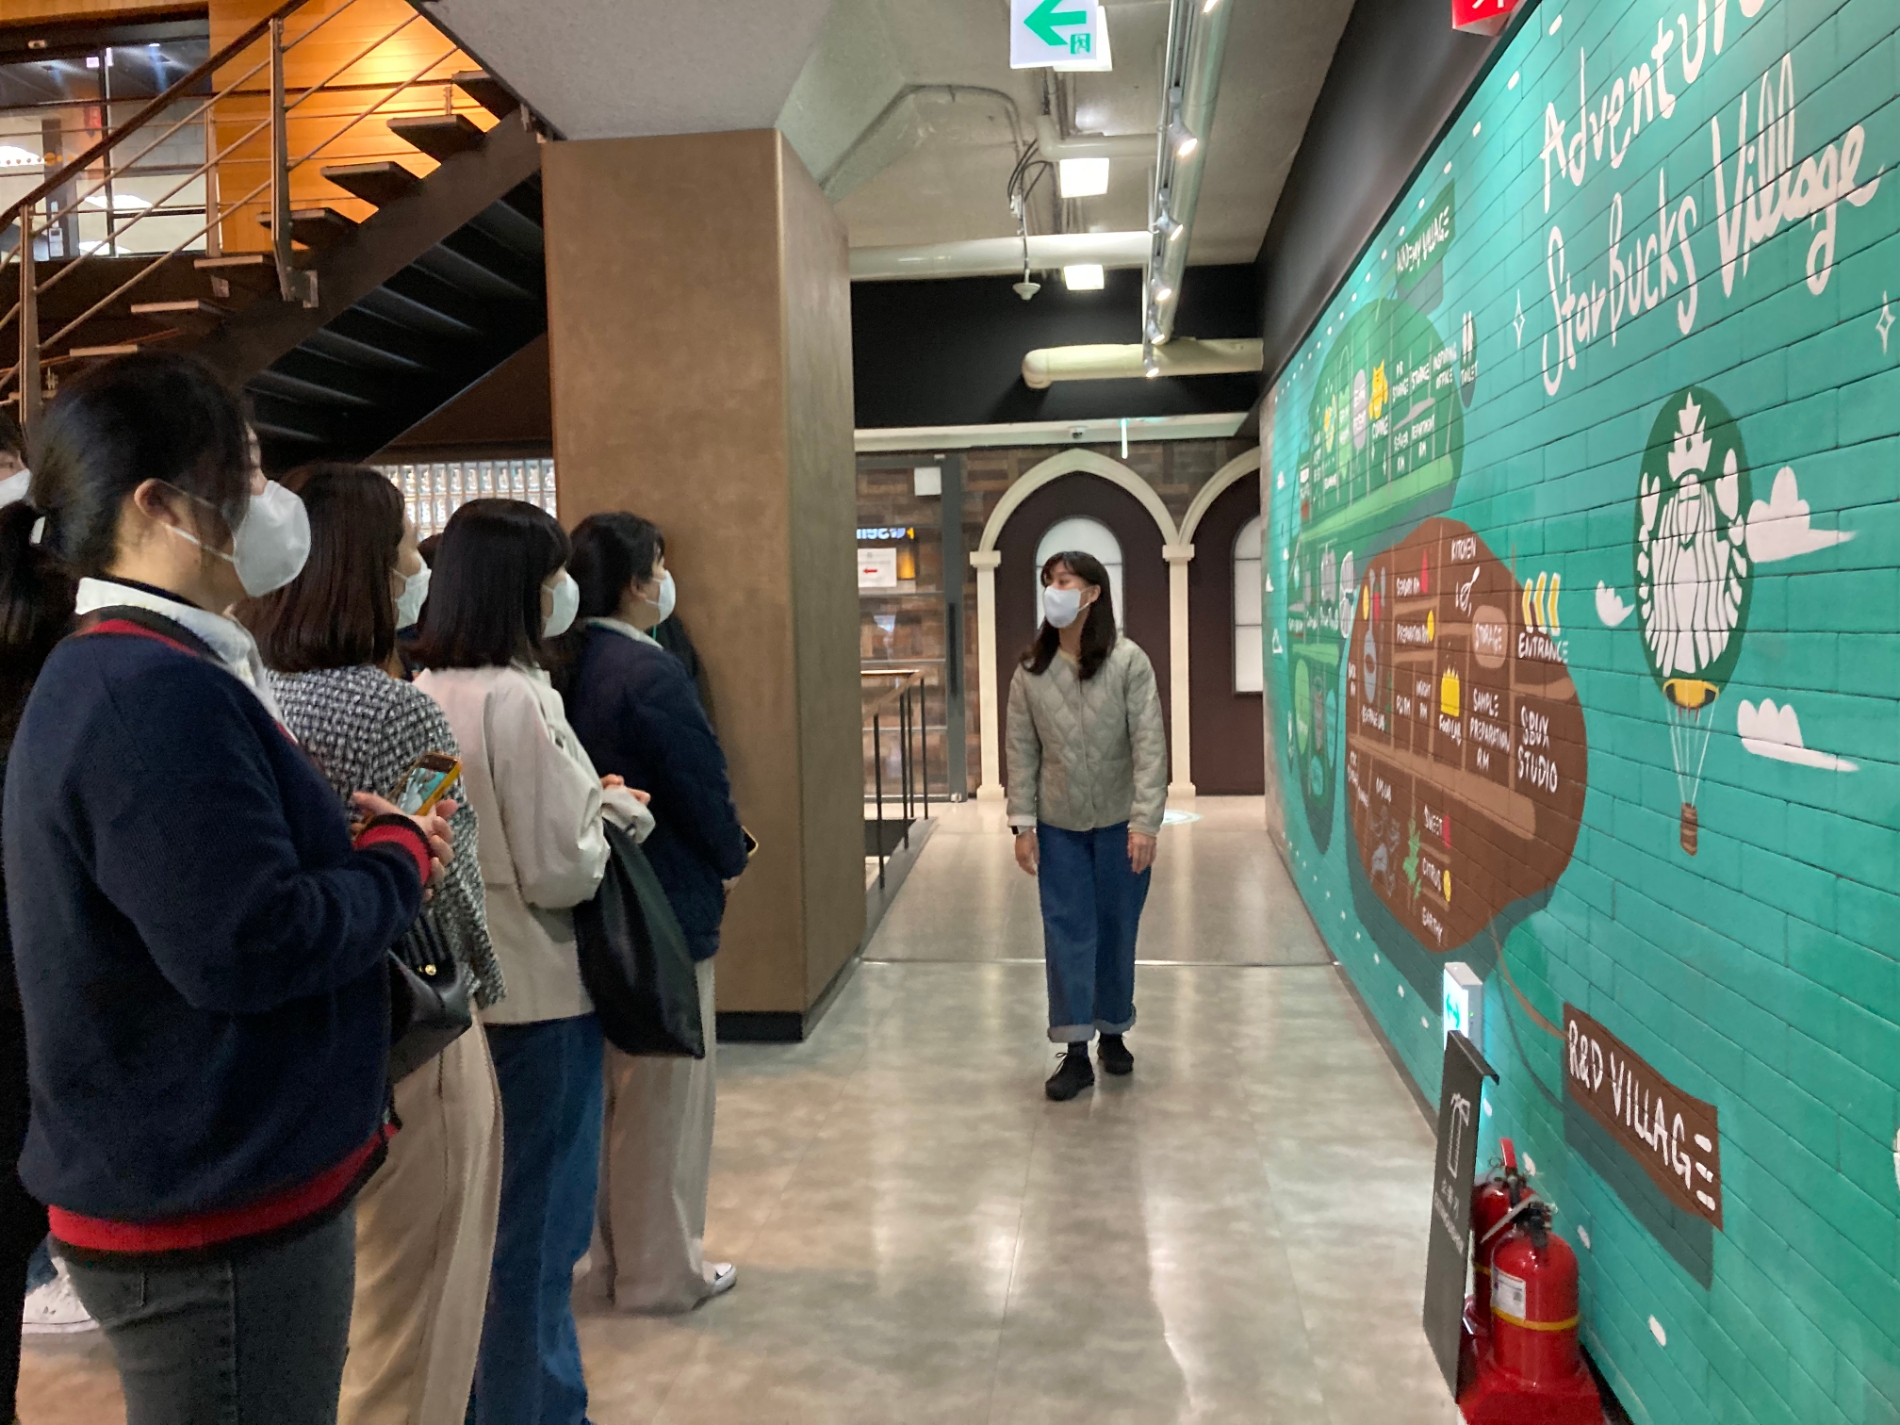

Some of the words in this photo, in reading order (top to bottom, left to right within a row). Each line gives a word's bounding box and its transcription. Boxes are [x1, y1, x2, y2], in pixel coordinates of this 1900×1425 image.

[1540, 0, 1767, 213] Adventur
[1712, 52, 1886, 298] Village
[1518, 632, 1569, 664] ENTRANCE
[1473, 688, 1499, 717] SAMPLE
[1470, 717, 1510, 754] PREPARATION
[1477, 748, 1490, 771] RM
[1518, 744, 1559, 793] STUDIO
[1568, 1019, 1604, 1094] R&D
[1610, 1051, 1716, 1212] VILLAGE
